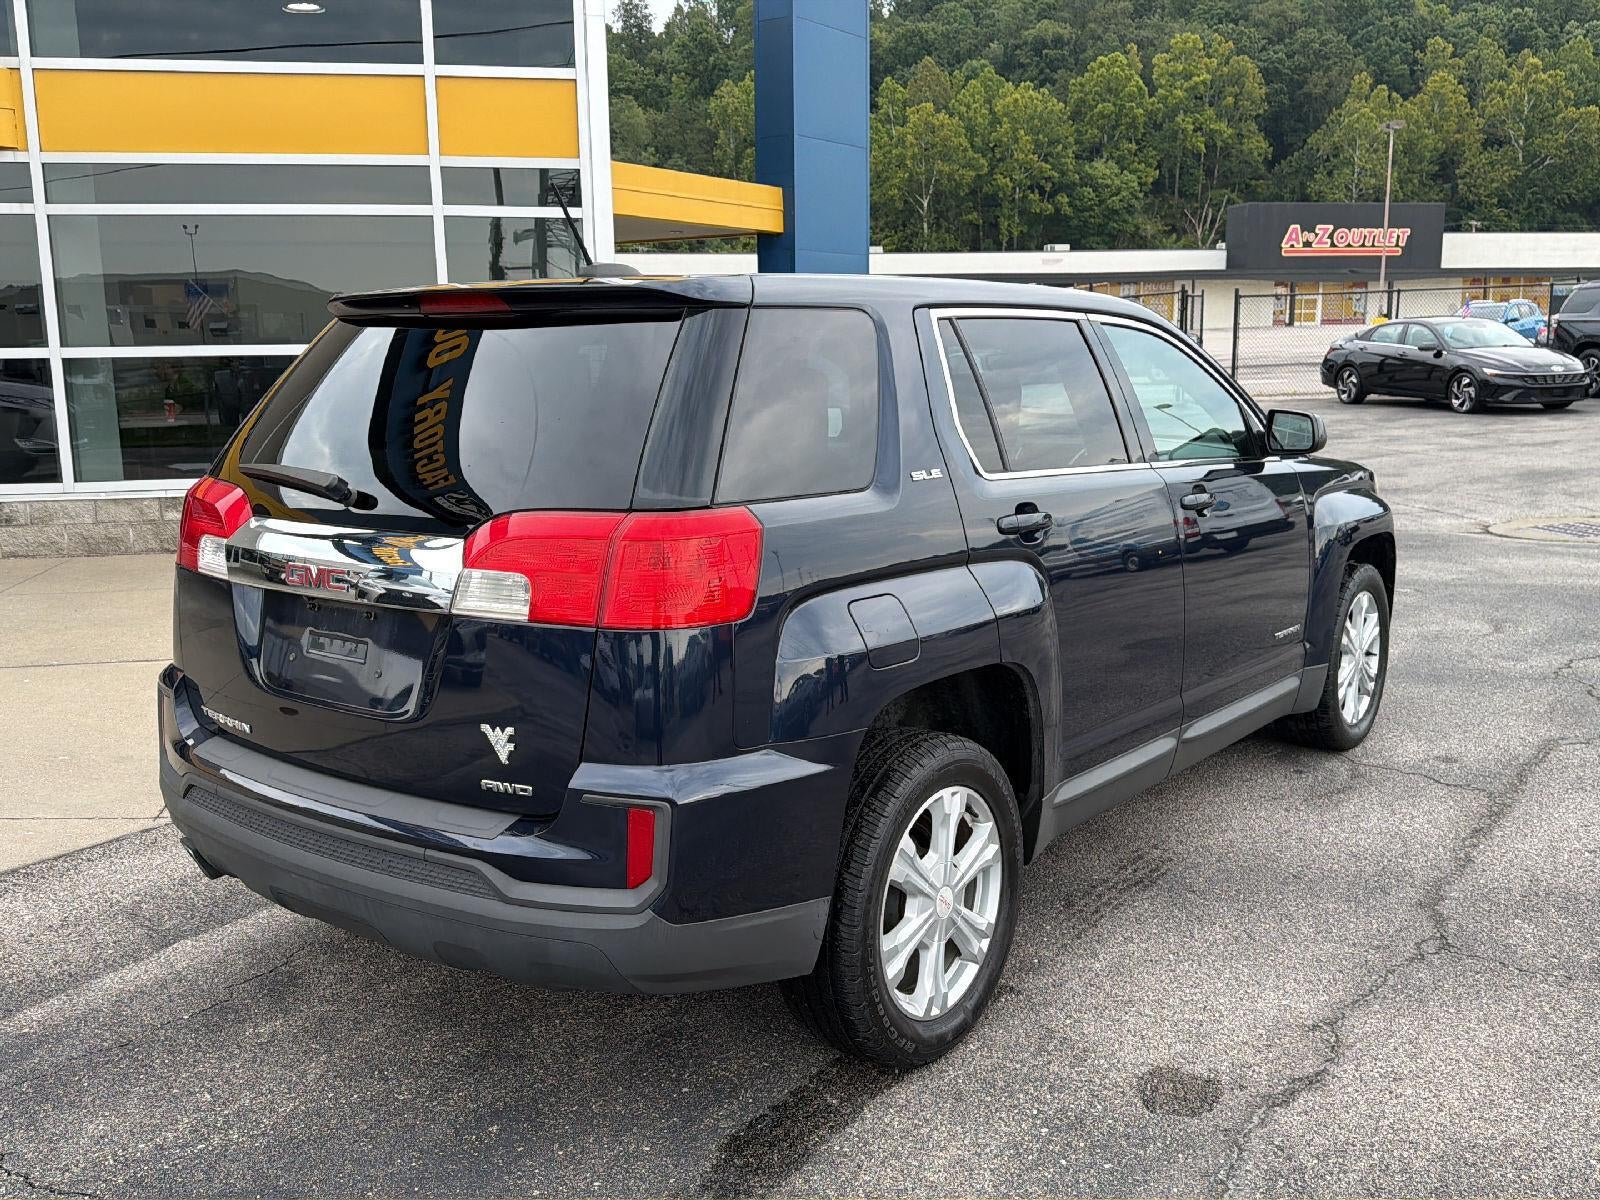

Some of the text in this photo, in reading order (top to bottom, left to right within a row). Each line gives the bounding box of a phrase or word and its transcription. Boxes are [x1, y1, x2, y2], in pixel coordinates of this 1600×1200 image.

[1333, 227, 1411, 247] OUTLET
[910, 468, 943, 481] SLE
[284, 561, 348, 592] GMC
[480, 779, 533, 797] AWD
